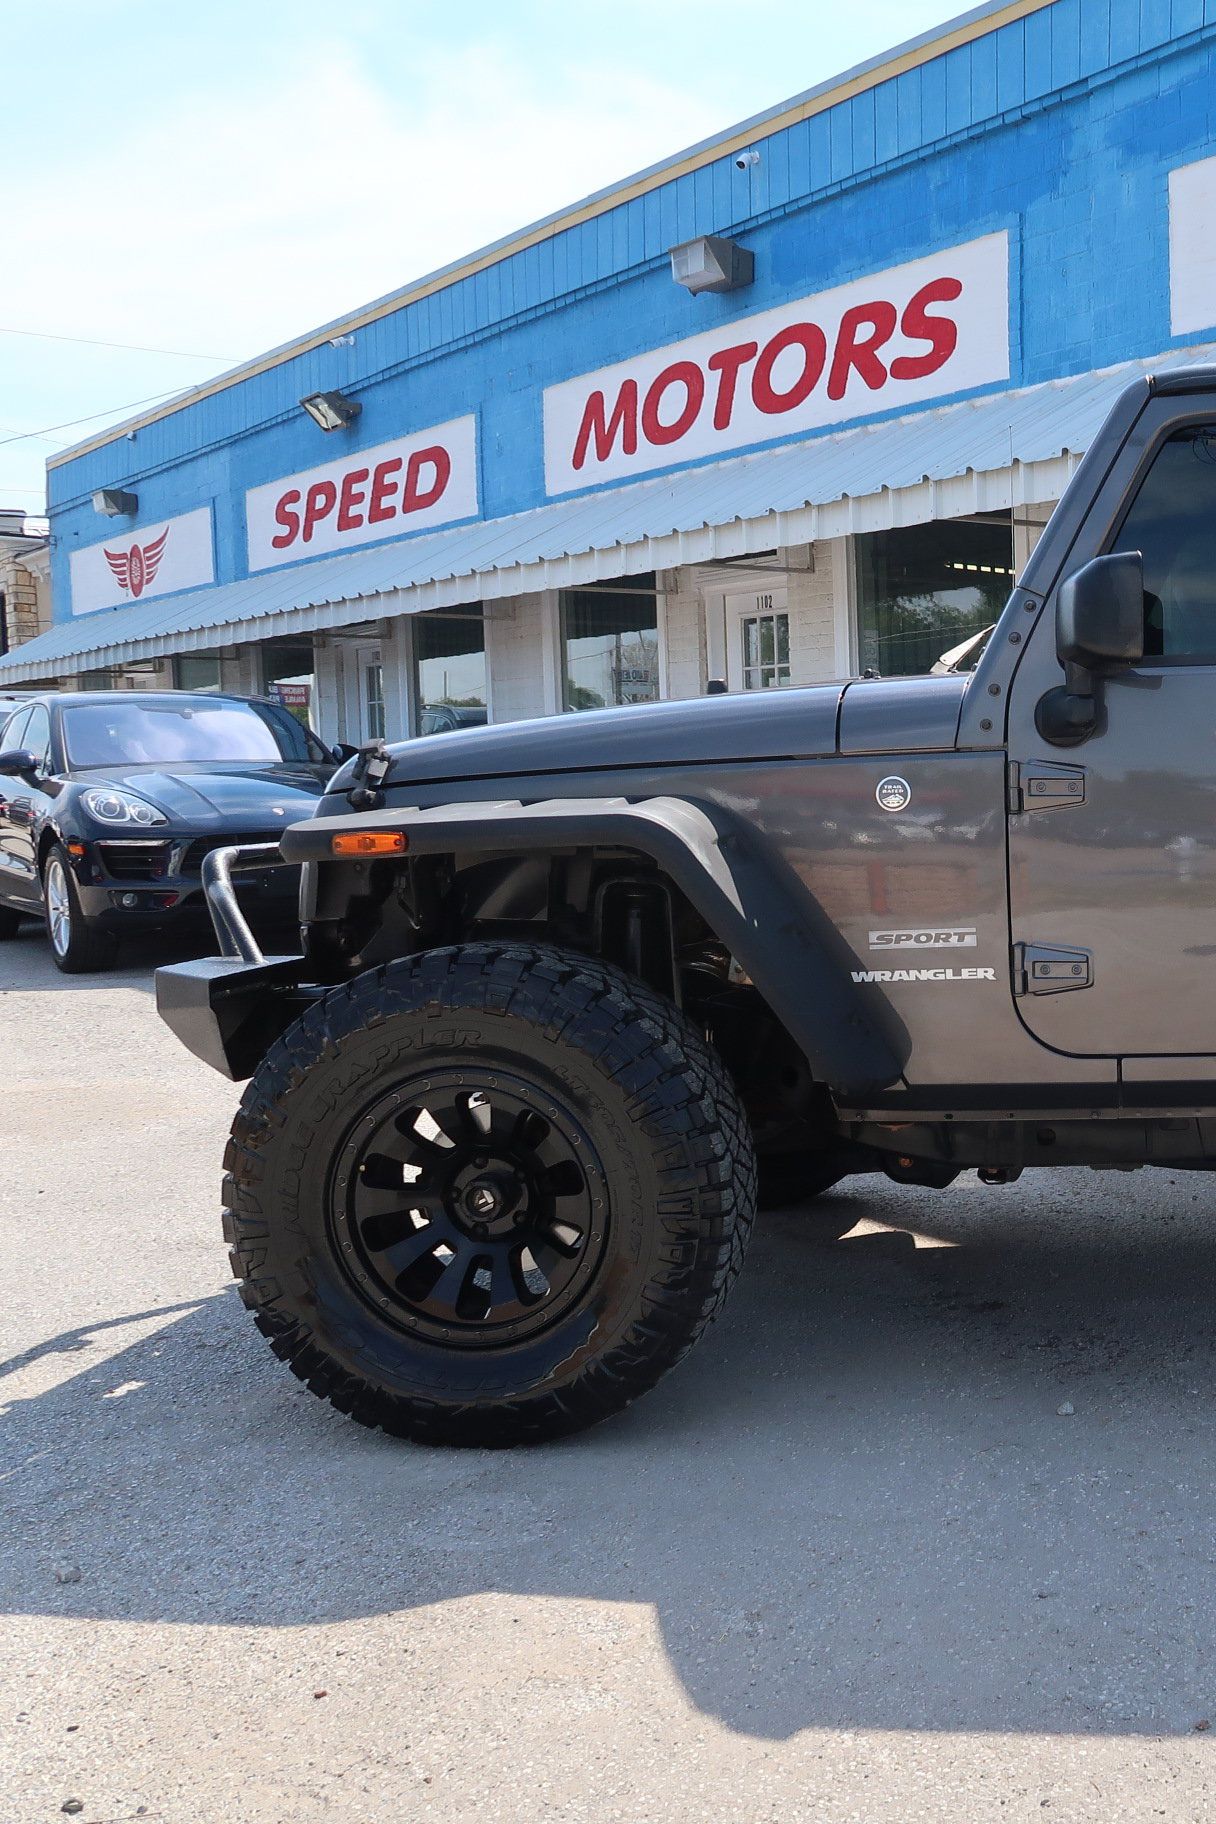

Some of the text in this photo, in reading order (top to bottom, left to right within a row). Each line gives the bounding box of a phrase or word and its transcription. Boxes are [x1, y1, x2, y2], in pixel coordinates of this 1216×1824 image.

[272, 277, 963, 549] SPEED MOTORS
[757, 594, 773, 610] 1102
[869, 931, 976, 946] SPORT
[850, 967, 997, 983] WRANGLER
